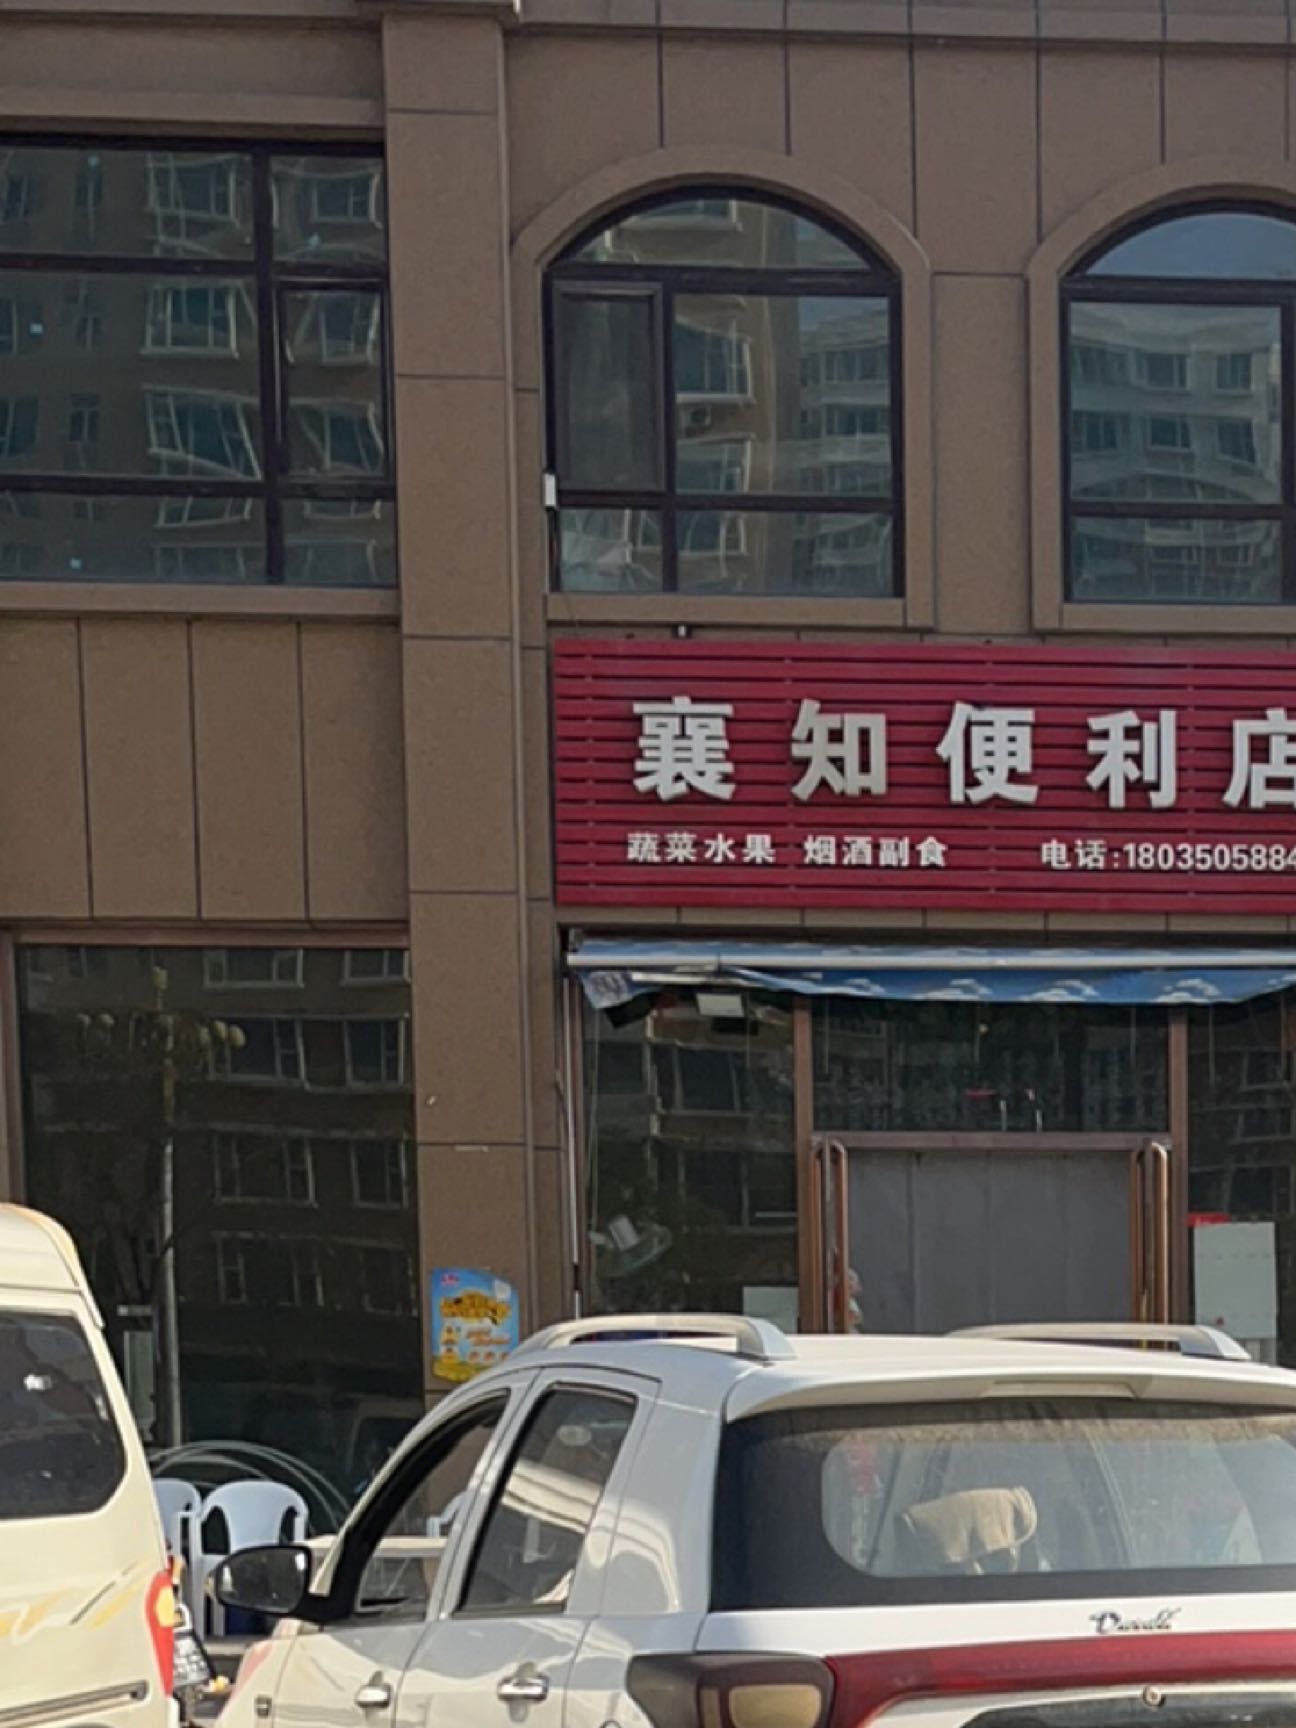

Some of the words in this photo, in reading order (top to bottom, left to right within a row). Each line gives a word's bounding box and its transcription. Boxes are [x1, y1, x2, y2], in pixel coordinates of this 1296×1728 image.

[627, 832, 775, 865] 蔬菜水果
[804, 834, 948, 868] 烟酒副食
